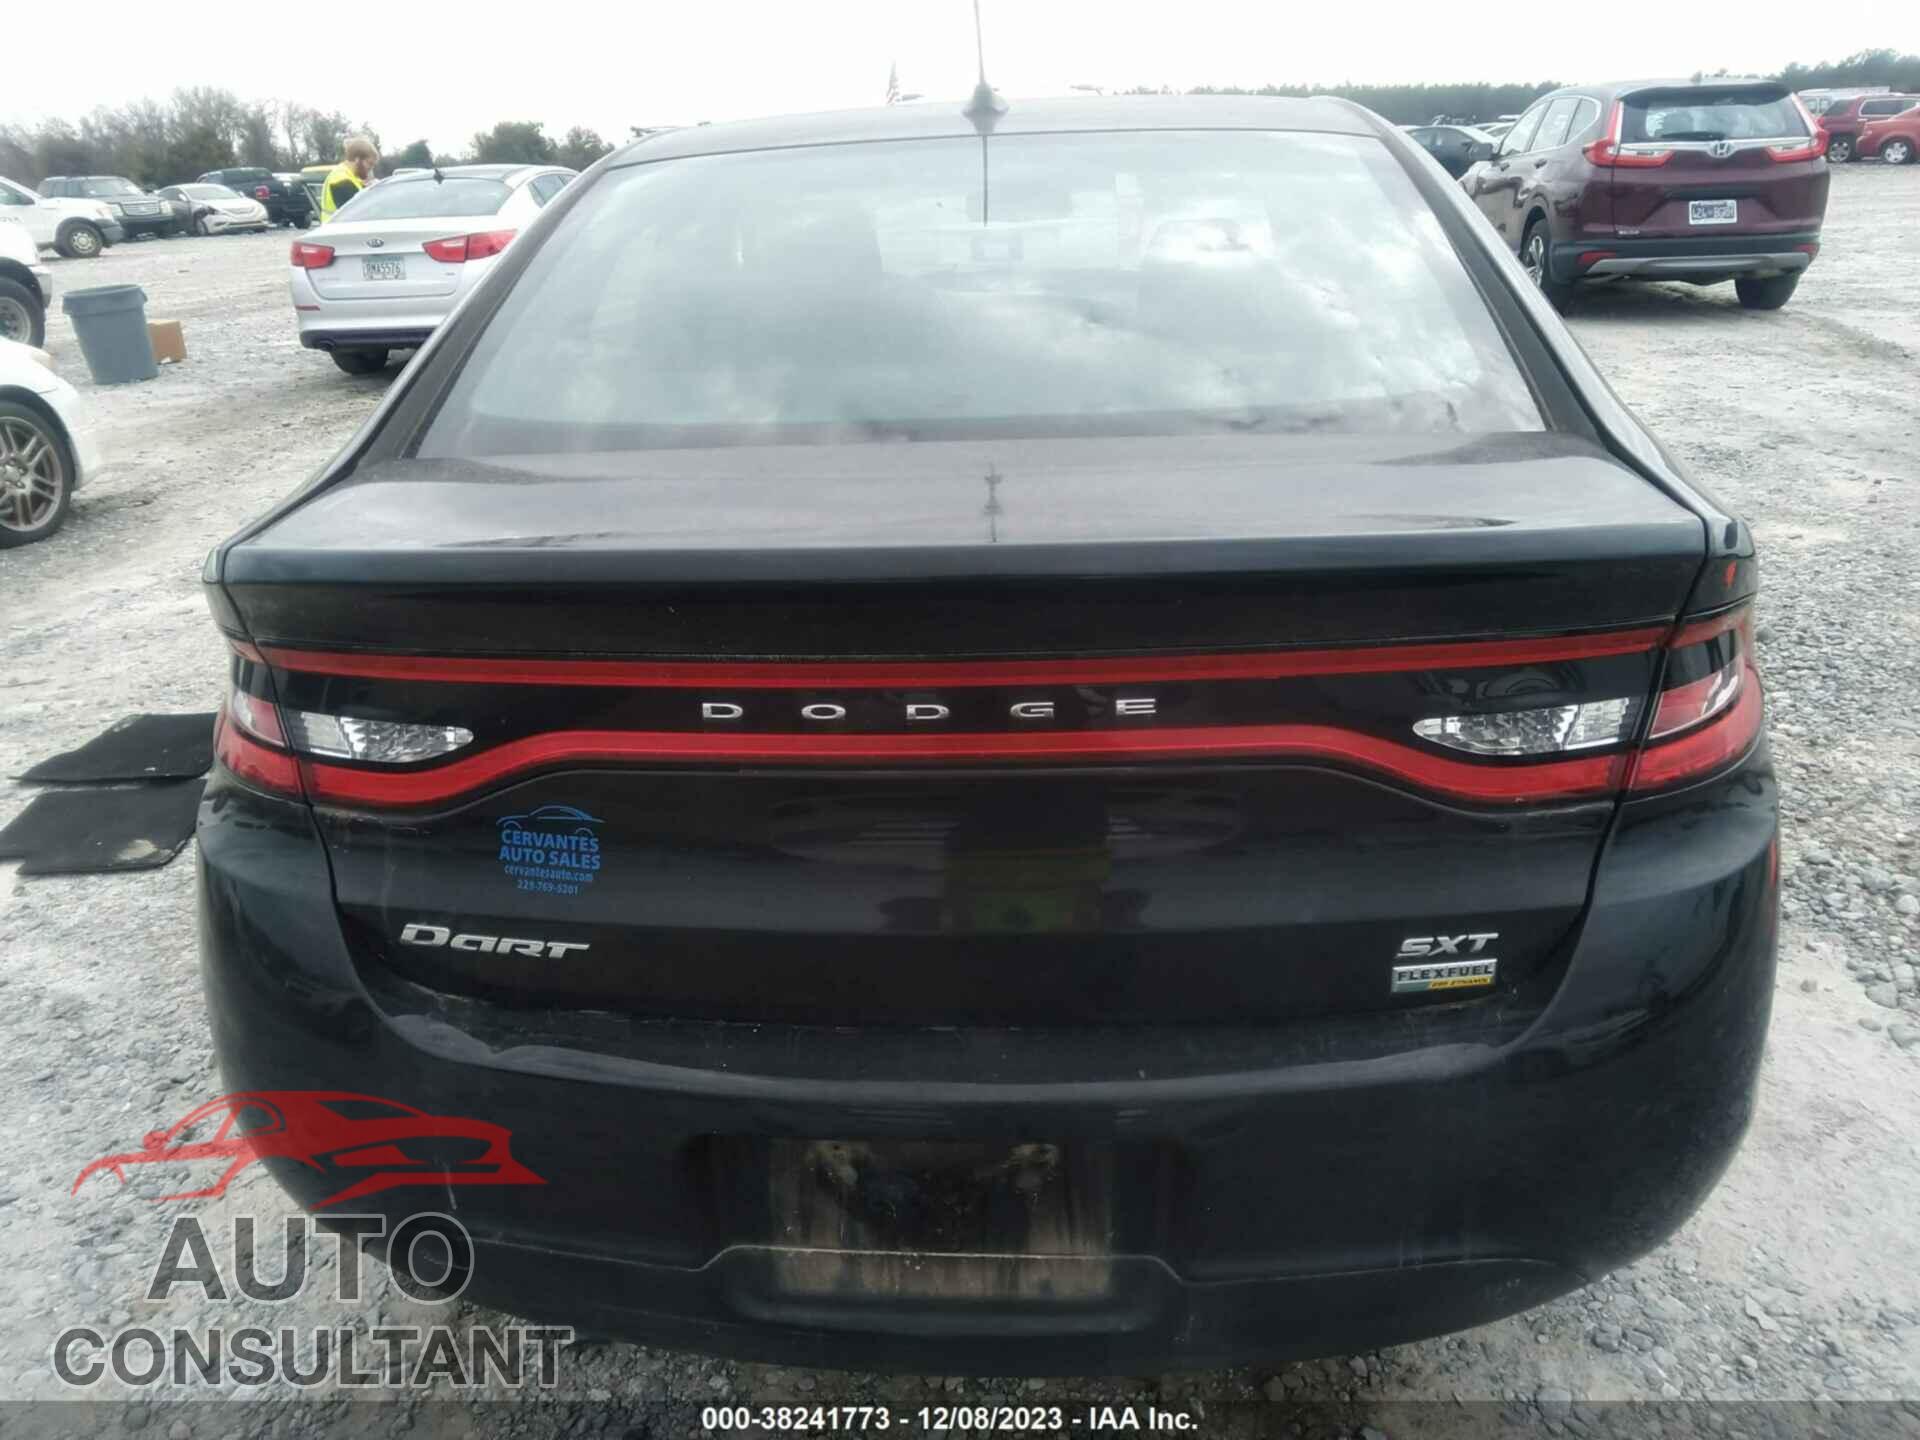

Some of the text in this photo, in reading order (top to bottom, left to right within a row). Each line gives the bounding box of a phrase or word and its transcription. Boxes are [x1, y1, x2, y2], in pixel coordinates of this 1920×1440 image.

[702, 698, 1156, 719] DODGE
[502, 829, 599, 852] CERVANTES
[499, 846, 600, 870] AUTO SALES
[1397, 932, 1499, 957] SXT
[1398, 964, 1493, 981] FLEXFUEL
